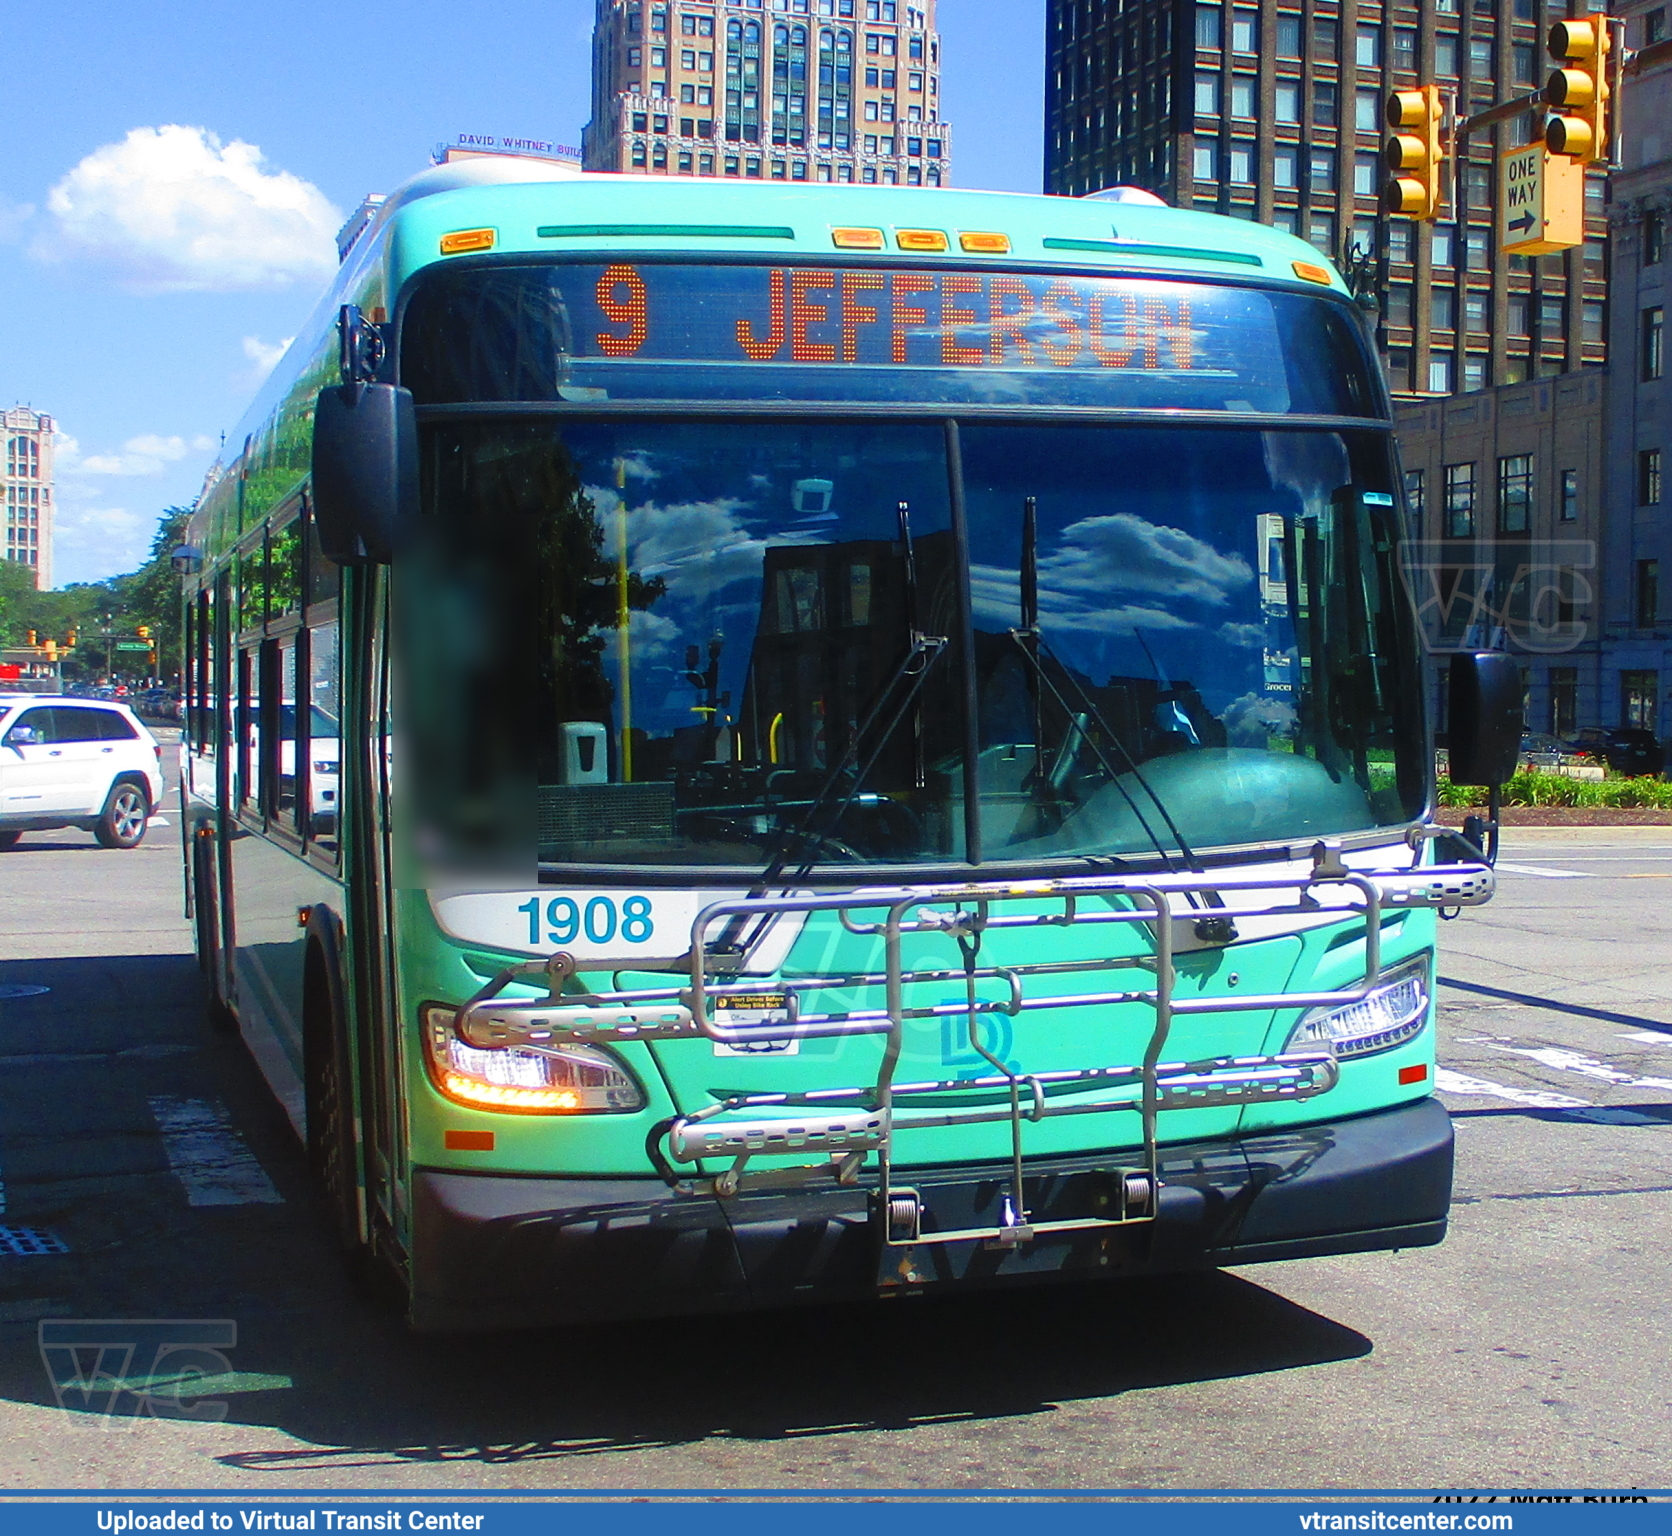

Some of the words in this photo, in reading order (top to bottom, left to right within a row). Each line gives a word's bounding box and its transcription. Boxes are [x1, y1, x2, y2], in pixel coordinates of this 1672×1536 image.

[459, 133, 495, 146] DAVID
[503, 137, 552, 152] WHITNEY
[1509, 155, 1536, 181] ONE
[1508, 180, 1537, 207] WAY
[596, 264, 646, 355] 9
[735, 269, 1192, 369] JEFFERSON
[518, 895, 654, 944] 1908
